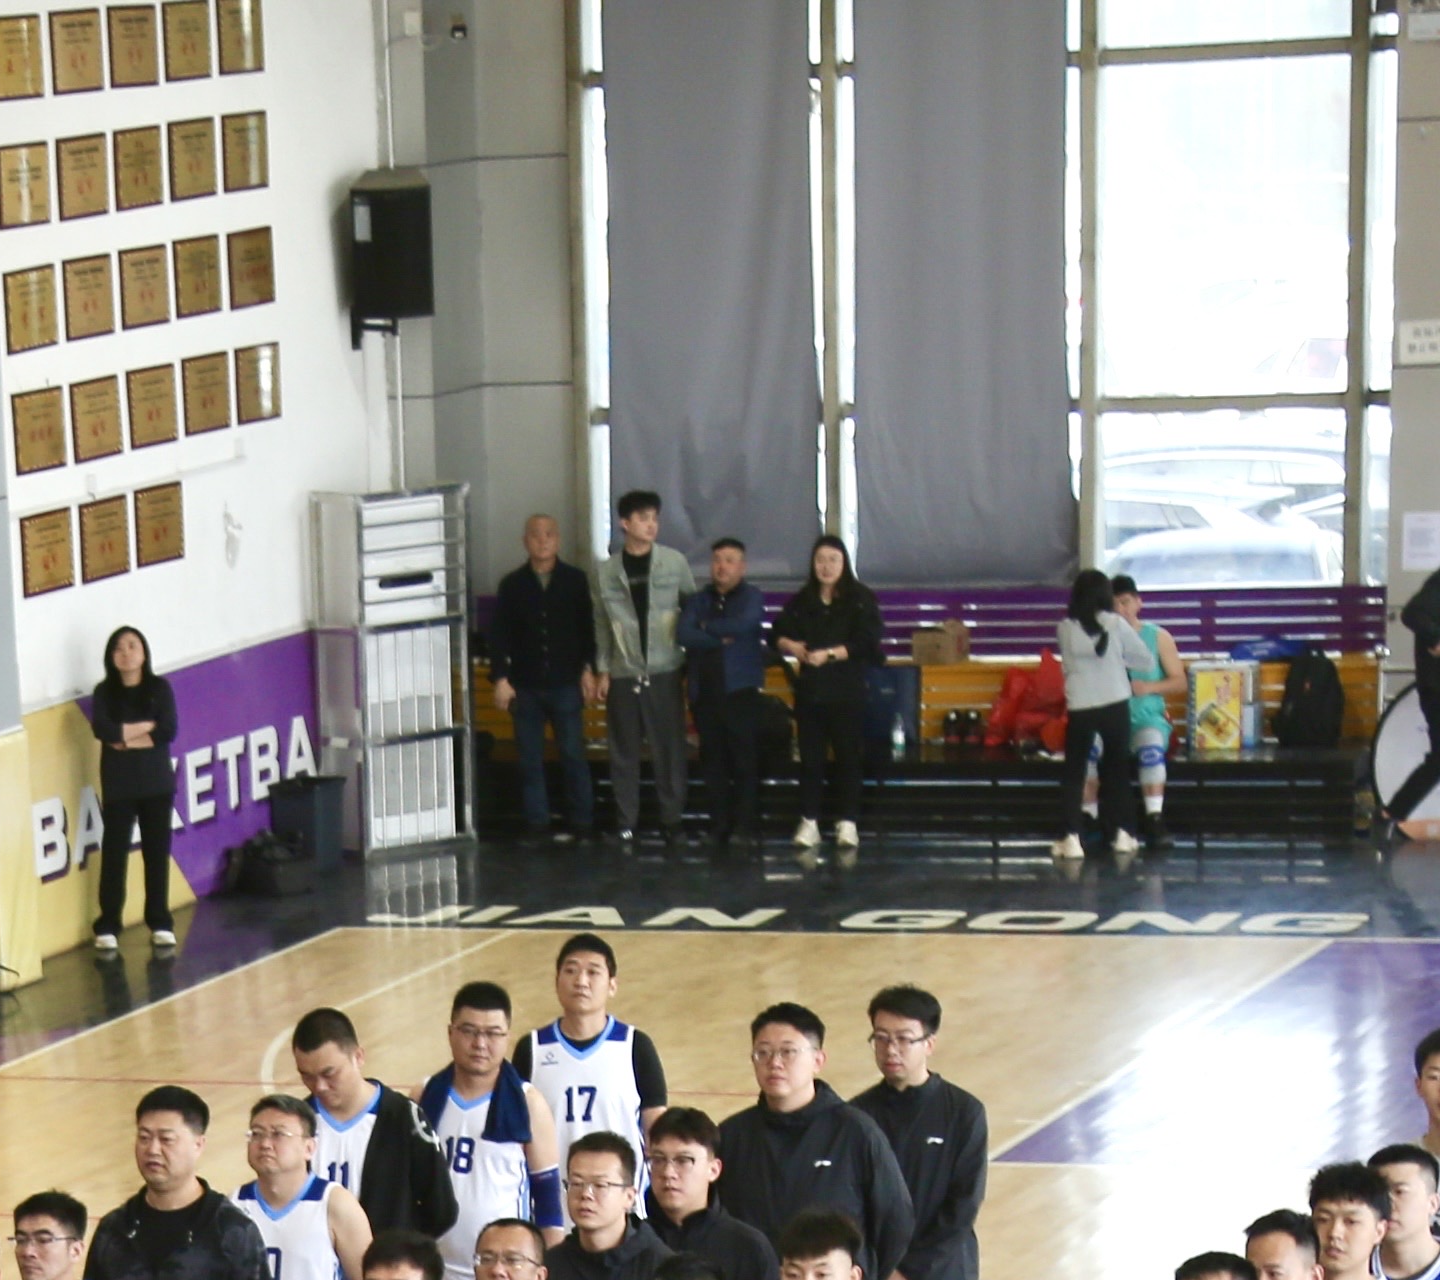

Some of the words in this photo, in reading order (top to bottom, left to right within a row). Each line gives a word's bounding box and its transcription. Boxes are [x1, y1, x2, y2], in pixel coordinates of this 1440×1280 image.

[32, 715, 318, 880] BAETBA
[366, 905, 788, 928] JIAN
[838, 909, 1372, 934] GONG
[564, 1086, 598, 1122] 17
[446, 1137, 476, 1174] 18
